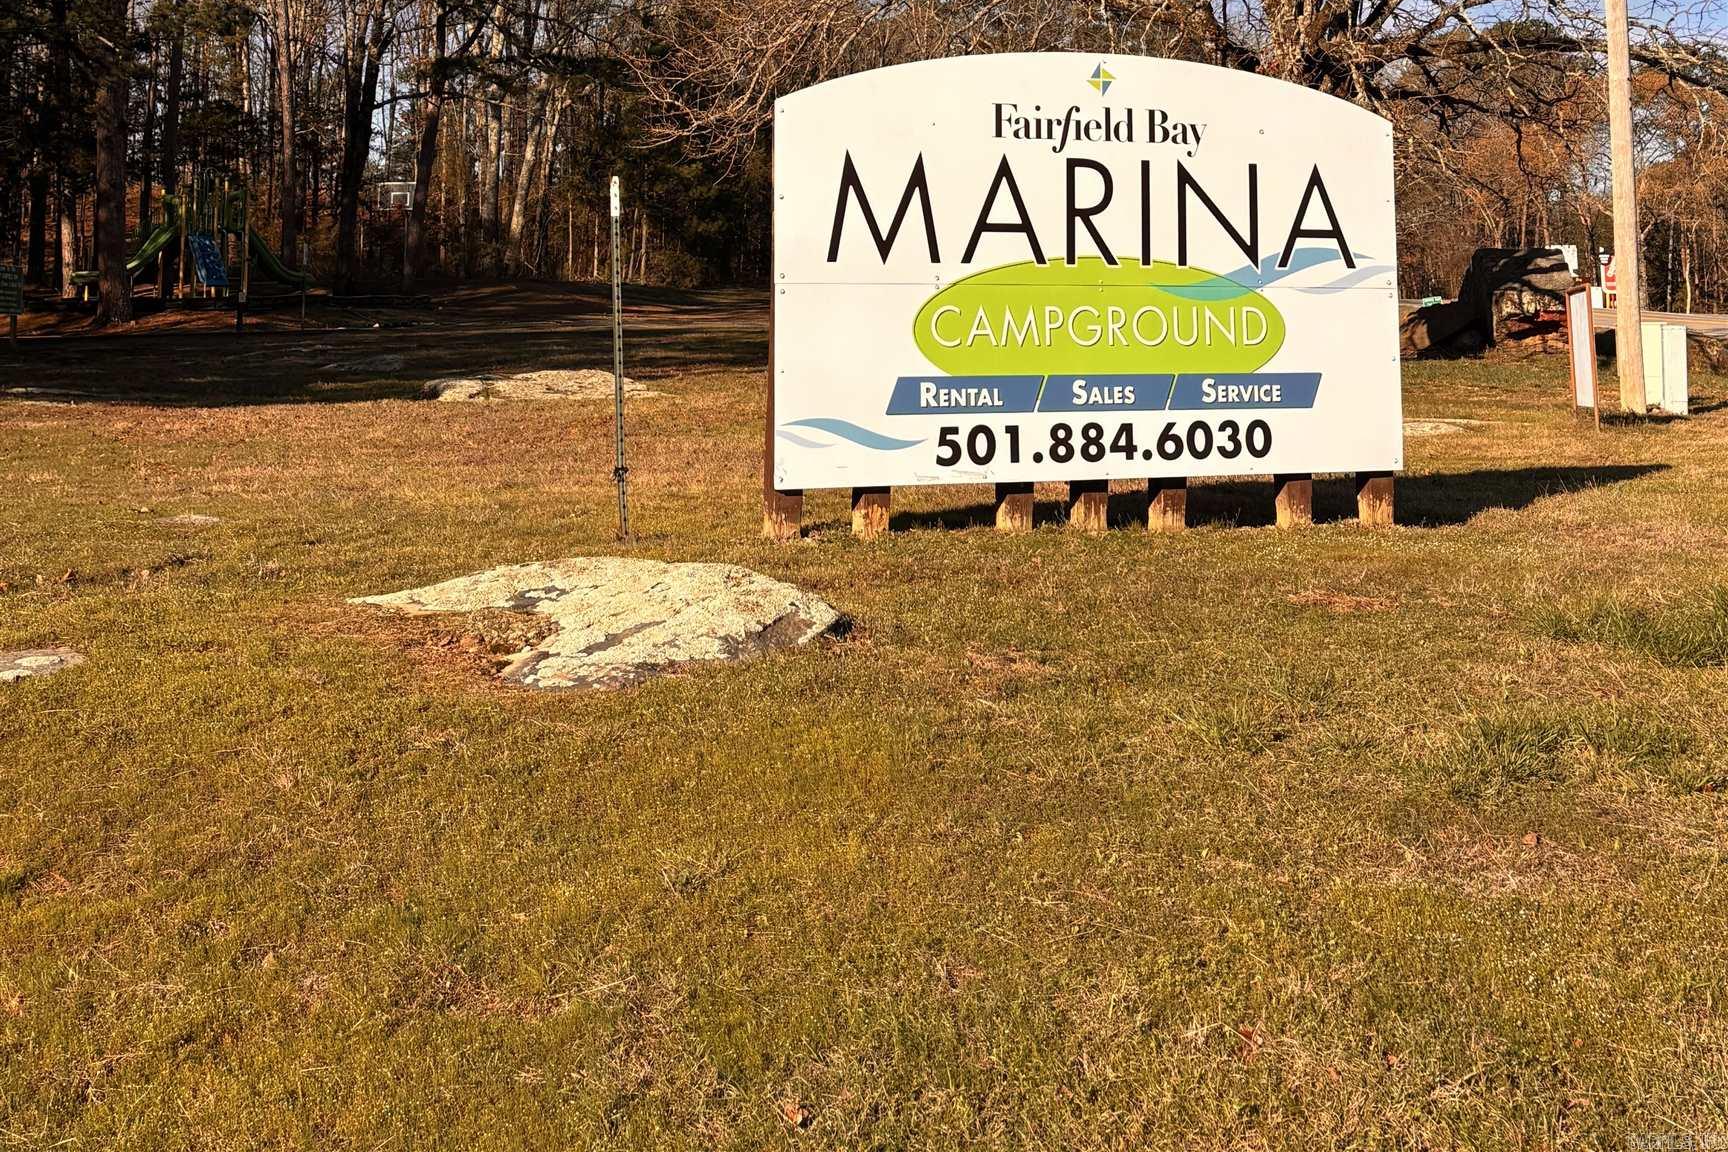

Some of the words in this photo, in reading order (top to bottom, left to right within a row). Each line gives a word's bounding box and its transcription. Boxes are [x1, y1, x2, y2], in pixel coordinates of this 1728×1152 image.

[991, 102, 1137, 154] Fairfield
[1144, 108, 1208, 158] Bay
[827, 147, 1357, 270] MARINA
[930, 304, 1269, 348] CAMPGROUND
[935, 418, 1273, 467] 501.884.6030
